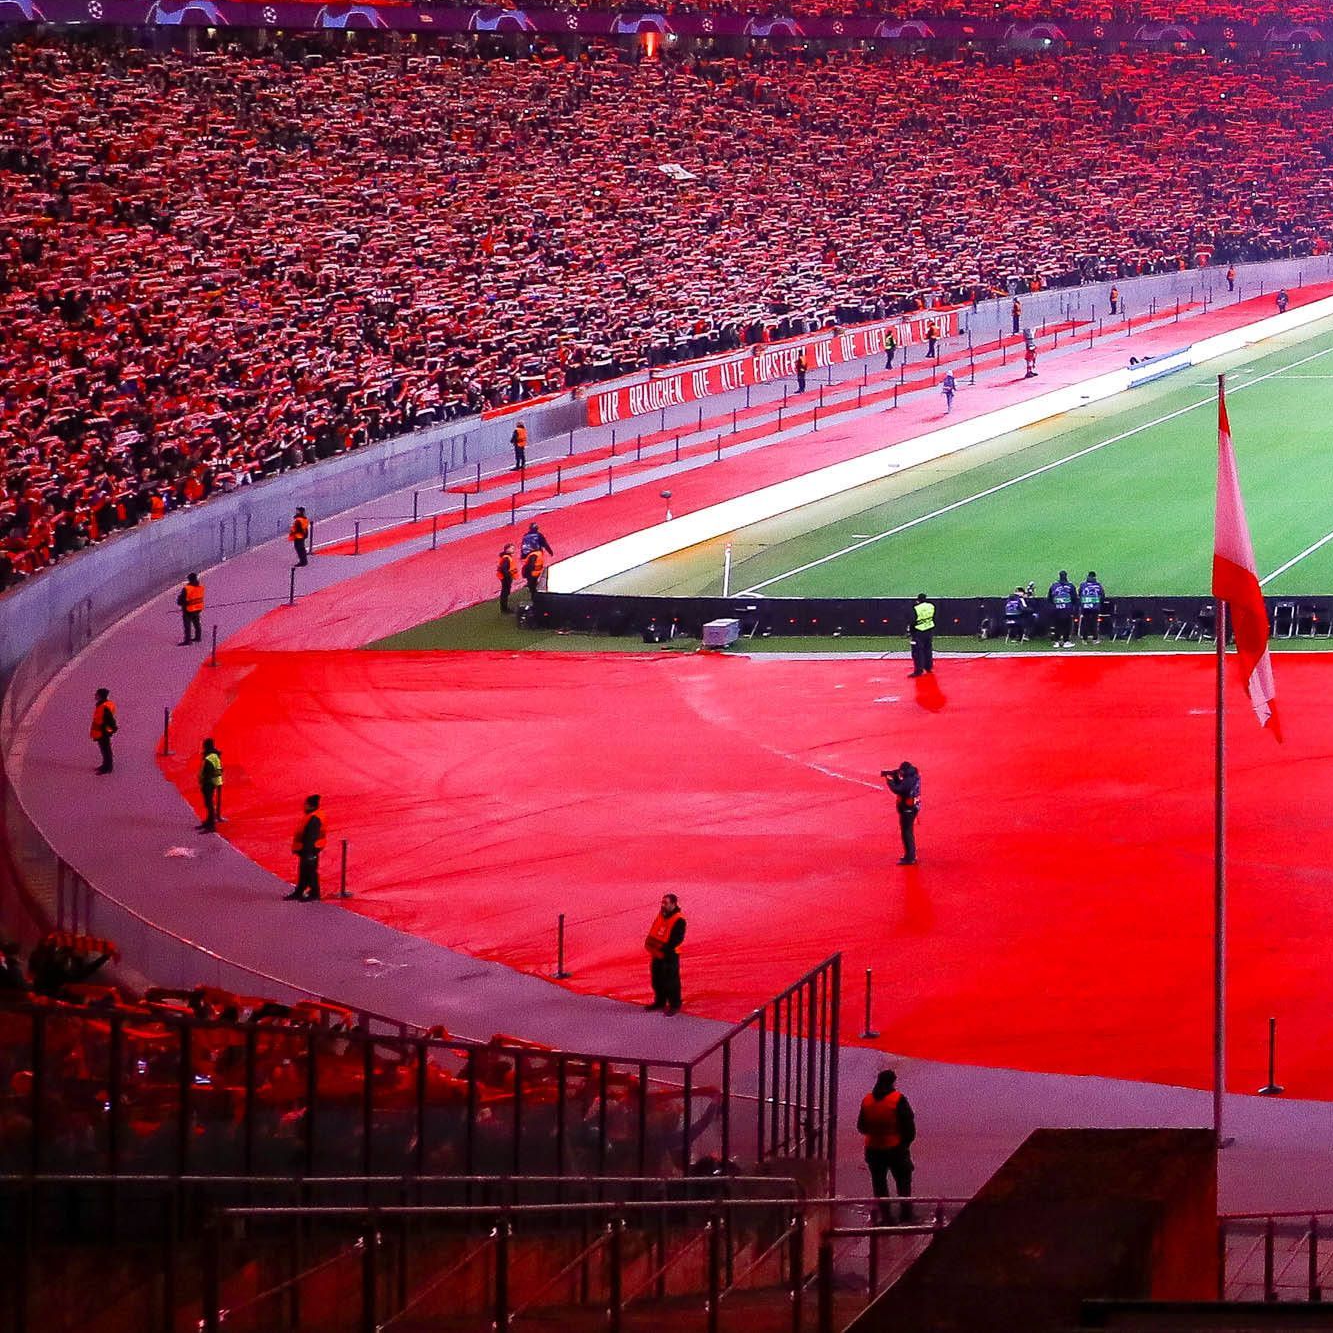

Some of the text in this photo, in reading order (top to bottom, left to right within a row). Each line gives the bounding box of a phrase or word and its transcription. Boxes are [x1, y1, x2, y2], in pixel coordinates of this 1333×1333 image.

[598, 391, 620, 423] WIR
[629, 376, 685, 415] BRAUCHEN
[692, 369, 710, 399] DIE
[719, 360, 745, 392] ALTE
[814, 339, 834, 366] WIE
[840, 333, 858, 360] DIE
[894, 322, 914, 349] ZUM
